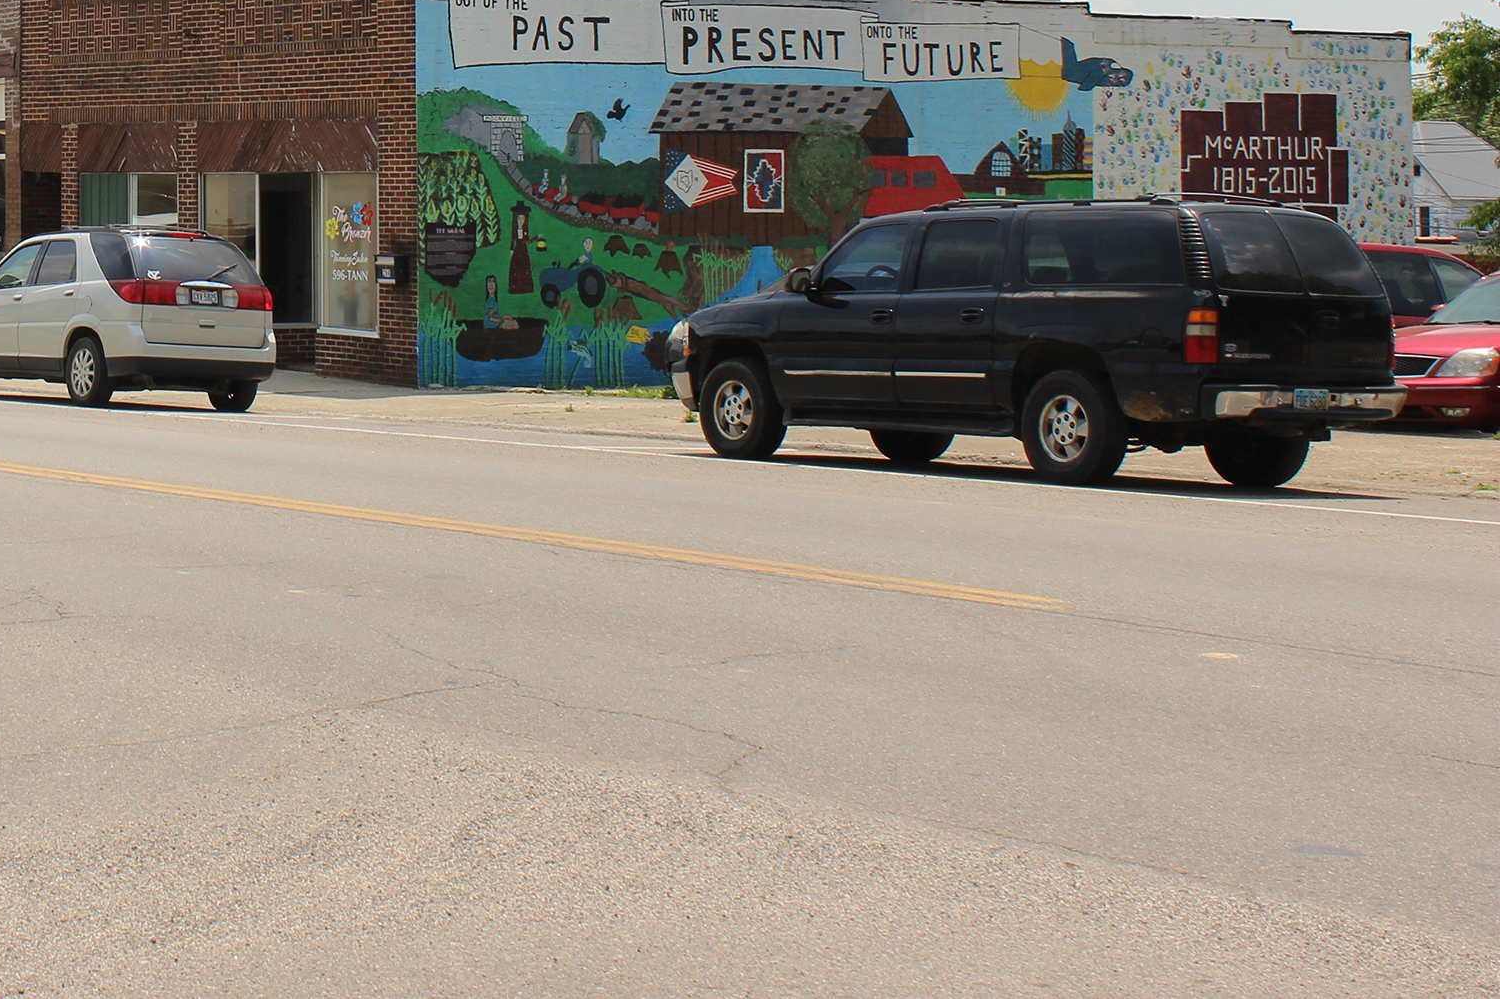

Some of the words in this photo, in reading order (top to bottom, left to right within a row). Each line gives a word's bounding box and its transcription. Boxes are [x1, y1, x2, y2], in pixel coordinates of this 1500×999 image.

[671, 8, 695, 22] INTO
[699, 8, 719, 23] THE
[512, 15, 610, 51] PAST
[866, 25, 893, 39] ONTO
[898, 26, 918, 40] THE
[682, 25, 845, 66] PRESENT
[882, 41, 1004, 77] FUTURE
[1213, 166, 1317, 194] 1815-2015
[332, 205, 348, 222] The
[332, 269, 368, 281] 596-TANN
